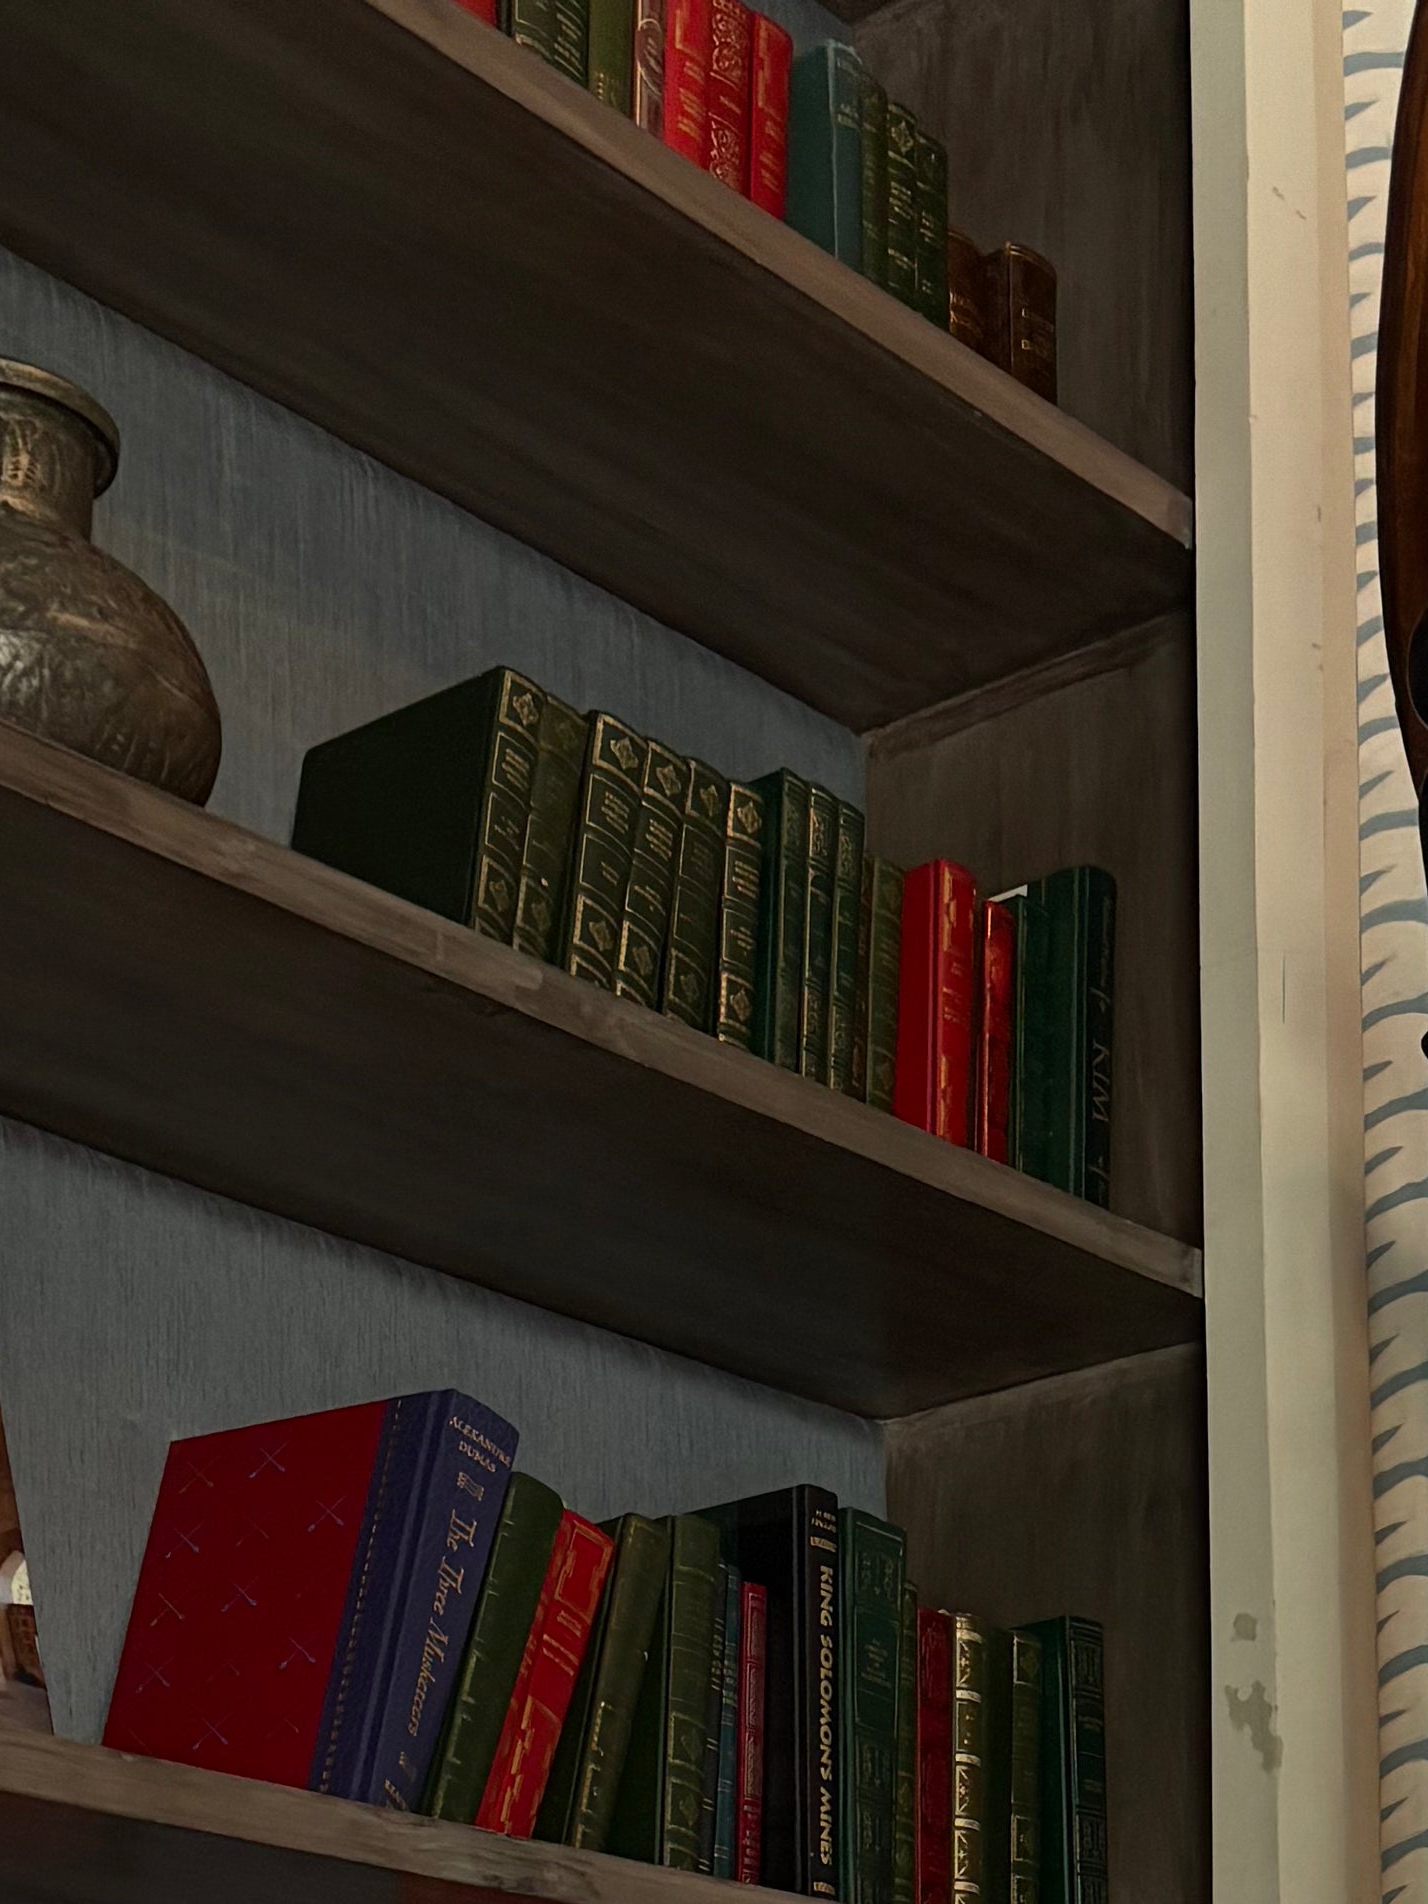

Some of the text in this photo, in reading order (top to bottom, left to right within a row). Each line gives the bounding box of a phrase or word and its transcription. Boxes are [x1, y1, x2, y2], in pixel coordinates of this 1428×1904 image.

[458, 1441, 497, 1472] DUMAS
[408, 1509, 477, 1737] The Three Musketeers
[819, 1563, 835, 1627] KING
[819, 1786, 835, 1866] MINES
